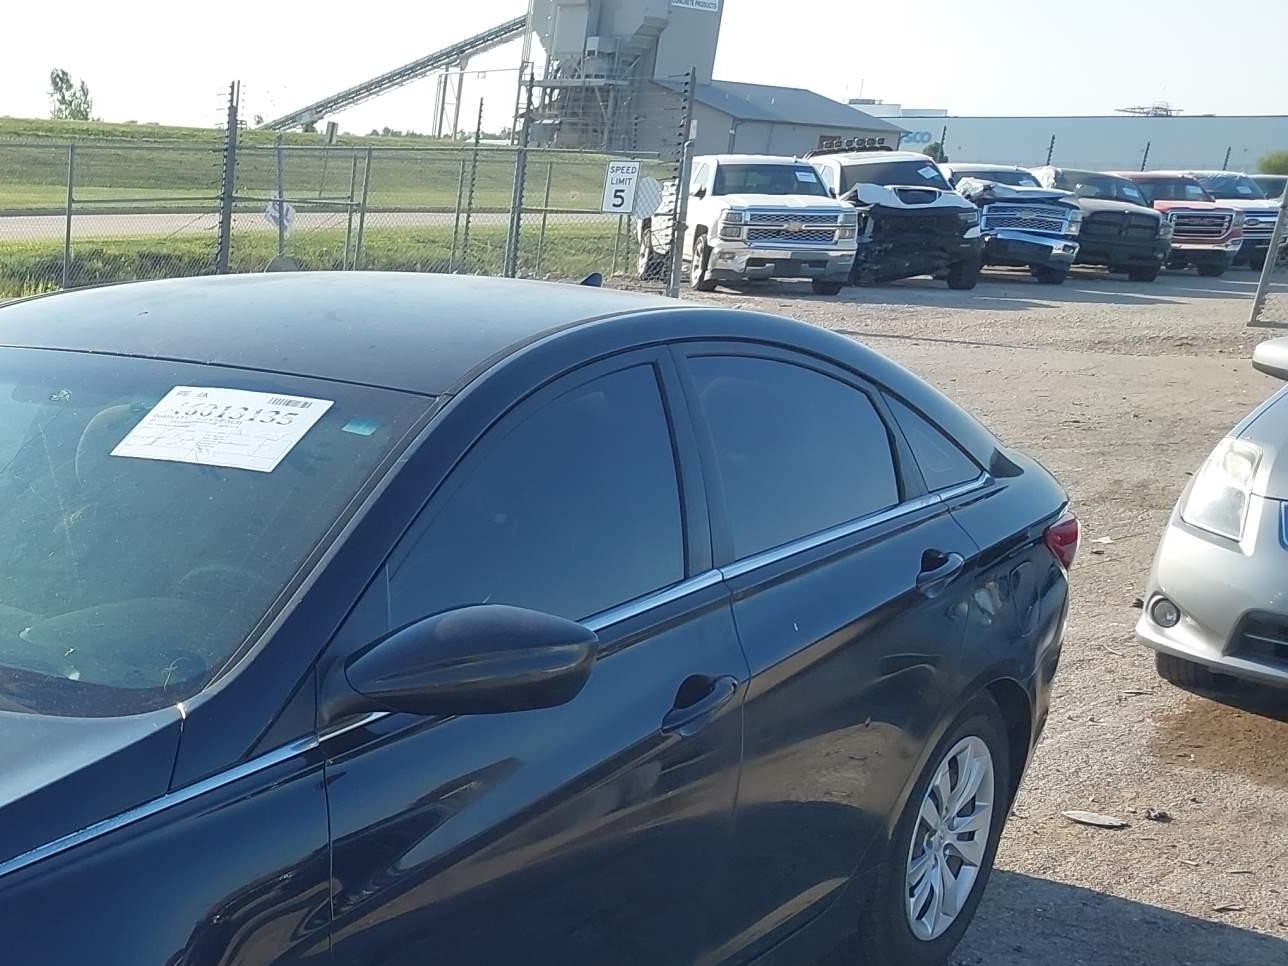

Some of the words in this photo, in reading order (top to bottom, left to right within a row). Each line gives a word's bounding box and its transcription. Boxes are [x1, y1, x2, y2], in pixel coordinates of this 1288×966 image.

[610, 166, 637, 174] SPEED
[611, 178, 633, 186] LIMIT
[612, 189, 626, 208] 5
